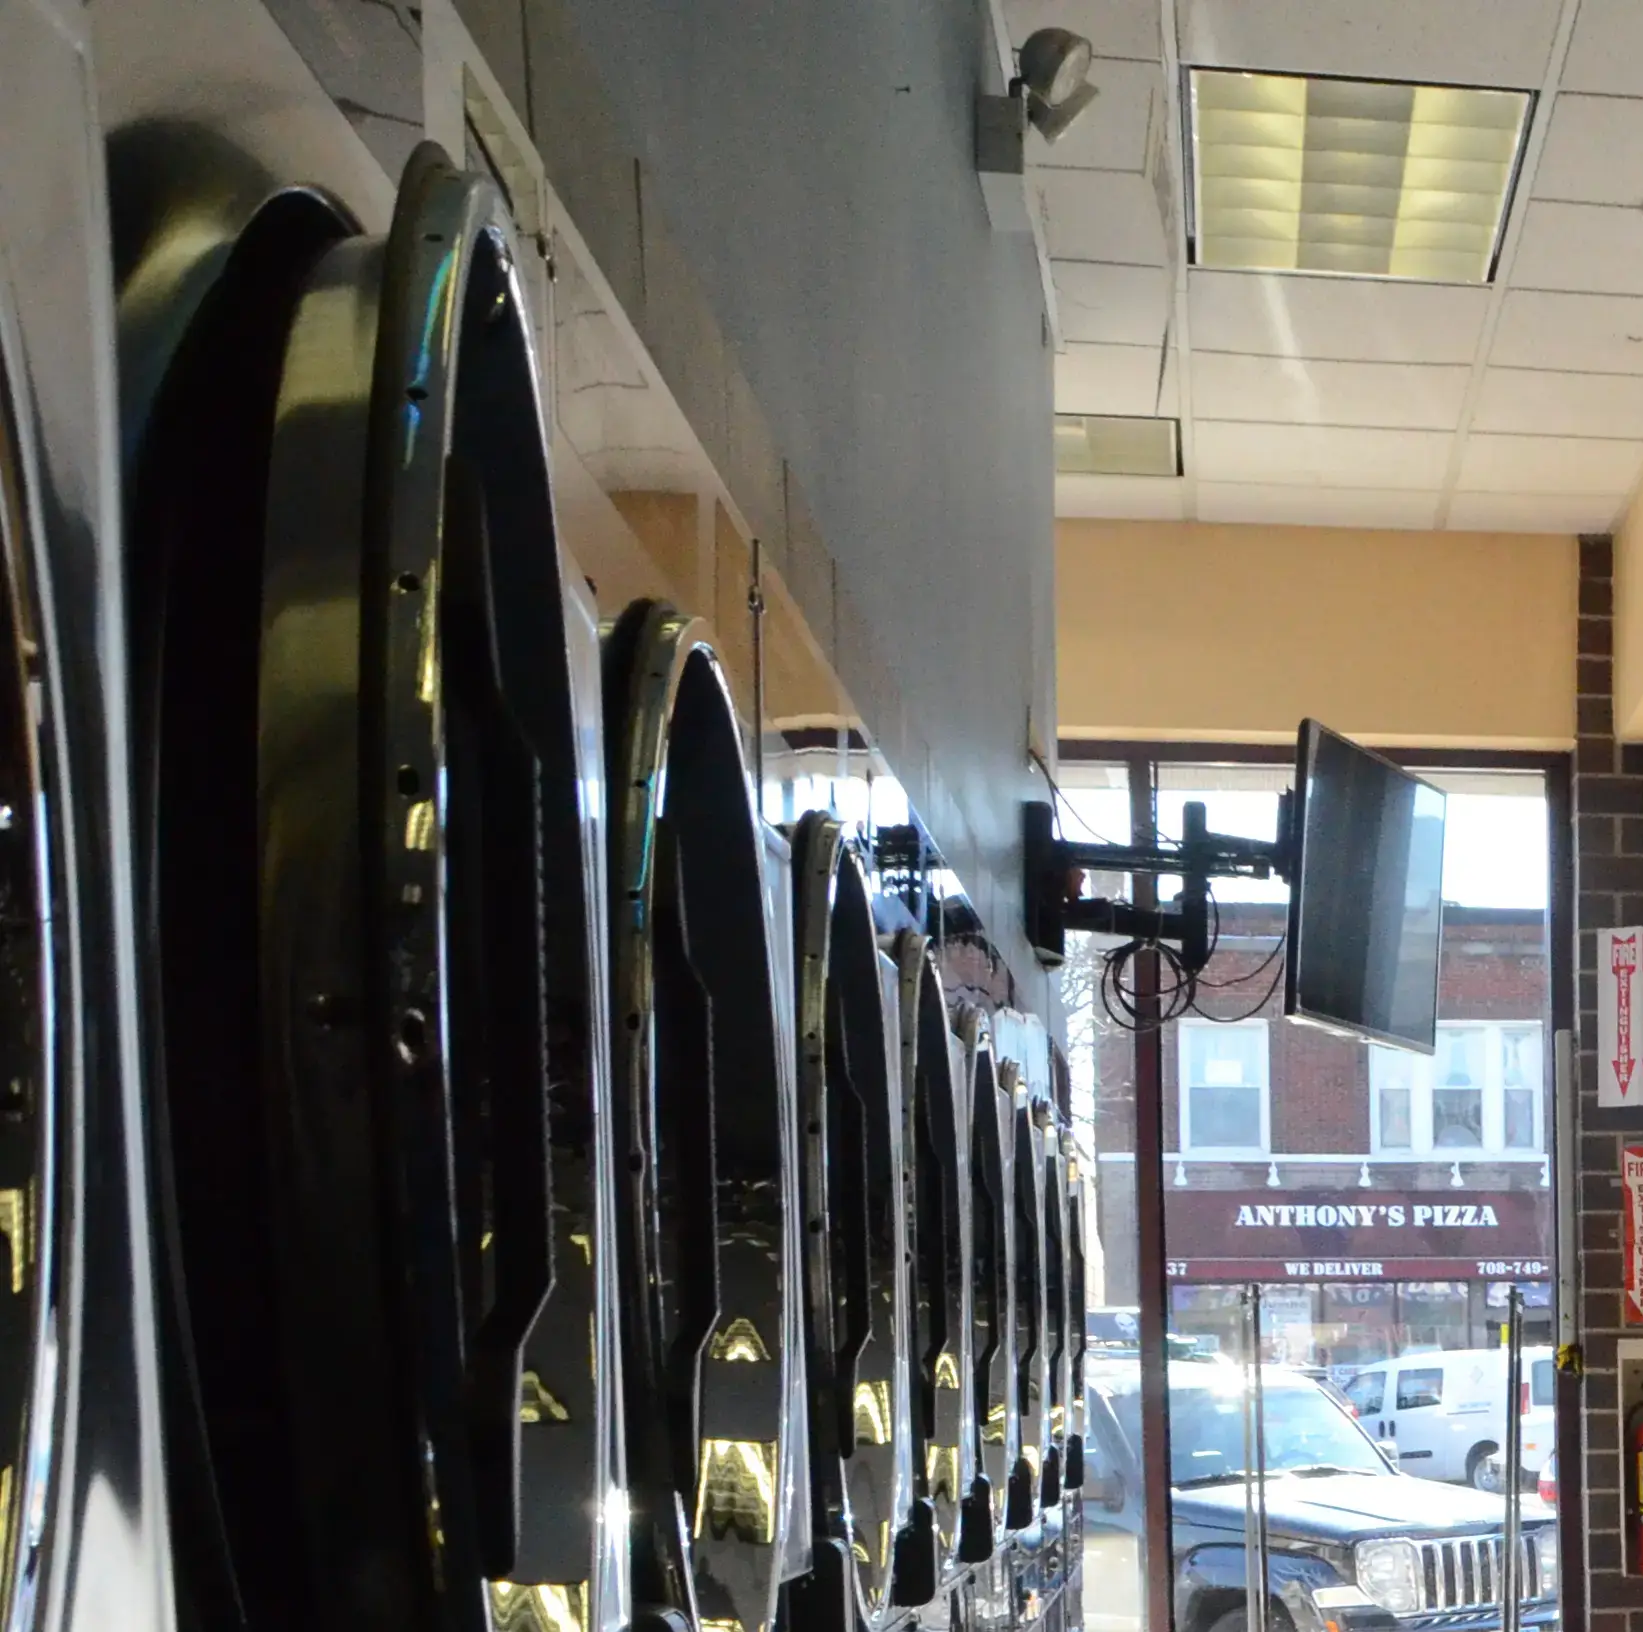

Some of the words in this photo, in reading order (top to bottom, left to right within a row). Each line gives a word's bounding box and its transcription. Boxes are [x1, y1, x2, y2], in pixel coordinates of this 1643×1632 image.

[1612, 943, 1636, 966] FIRE
[1235, 1204, 1406, 1227] ANTHONY'S
[1412, 1204, 1499, 1227] PIZZA
[1285, 1262, 1311, 1276] WE
[1313, 1262, 1384, 1276] DELIVER
[1476, 1261, 1549, 1276] 708-749-
